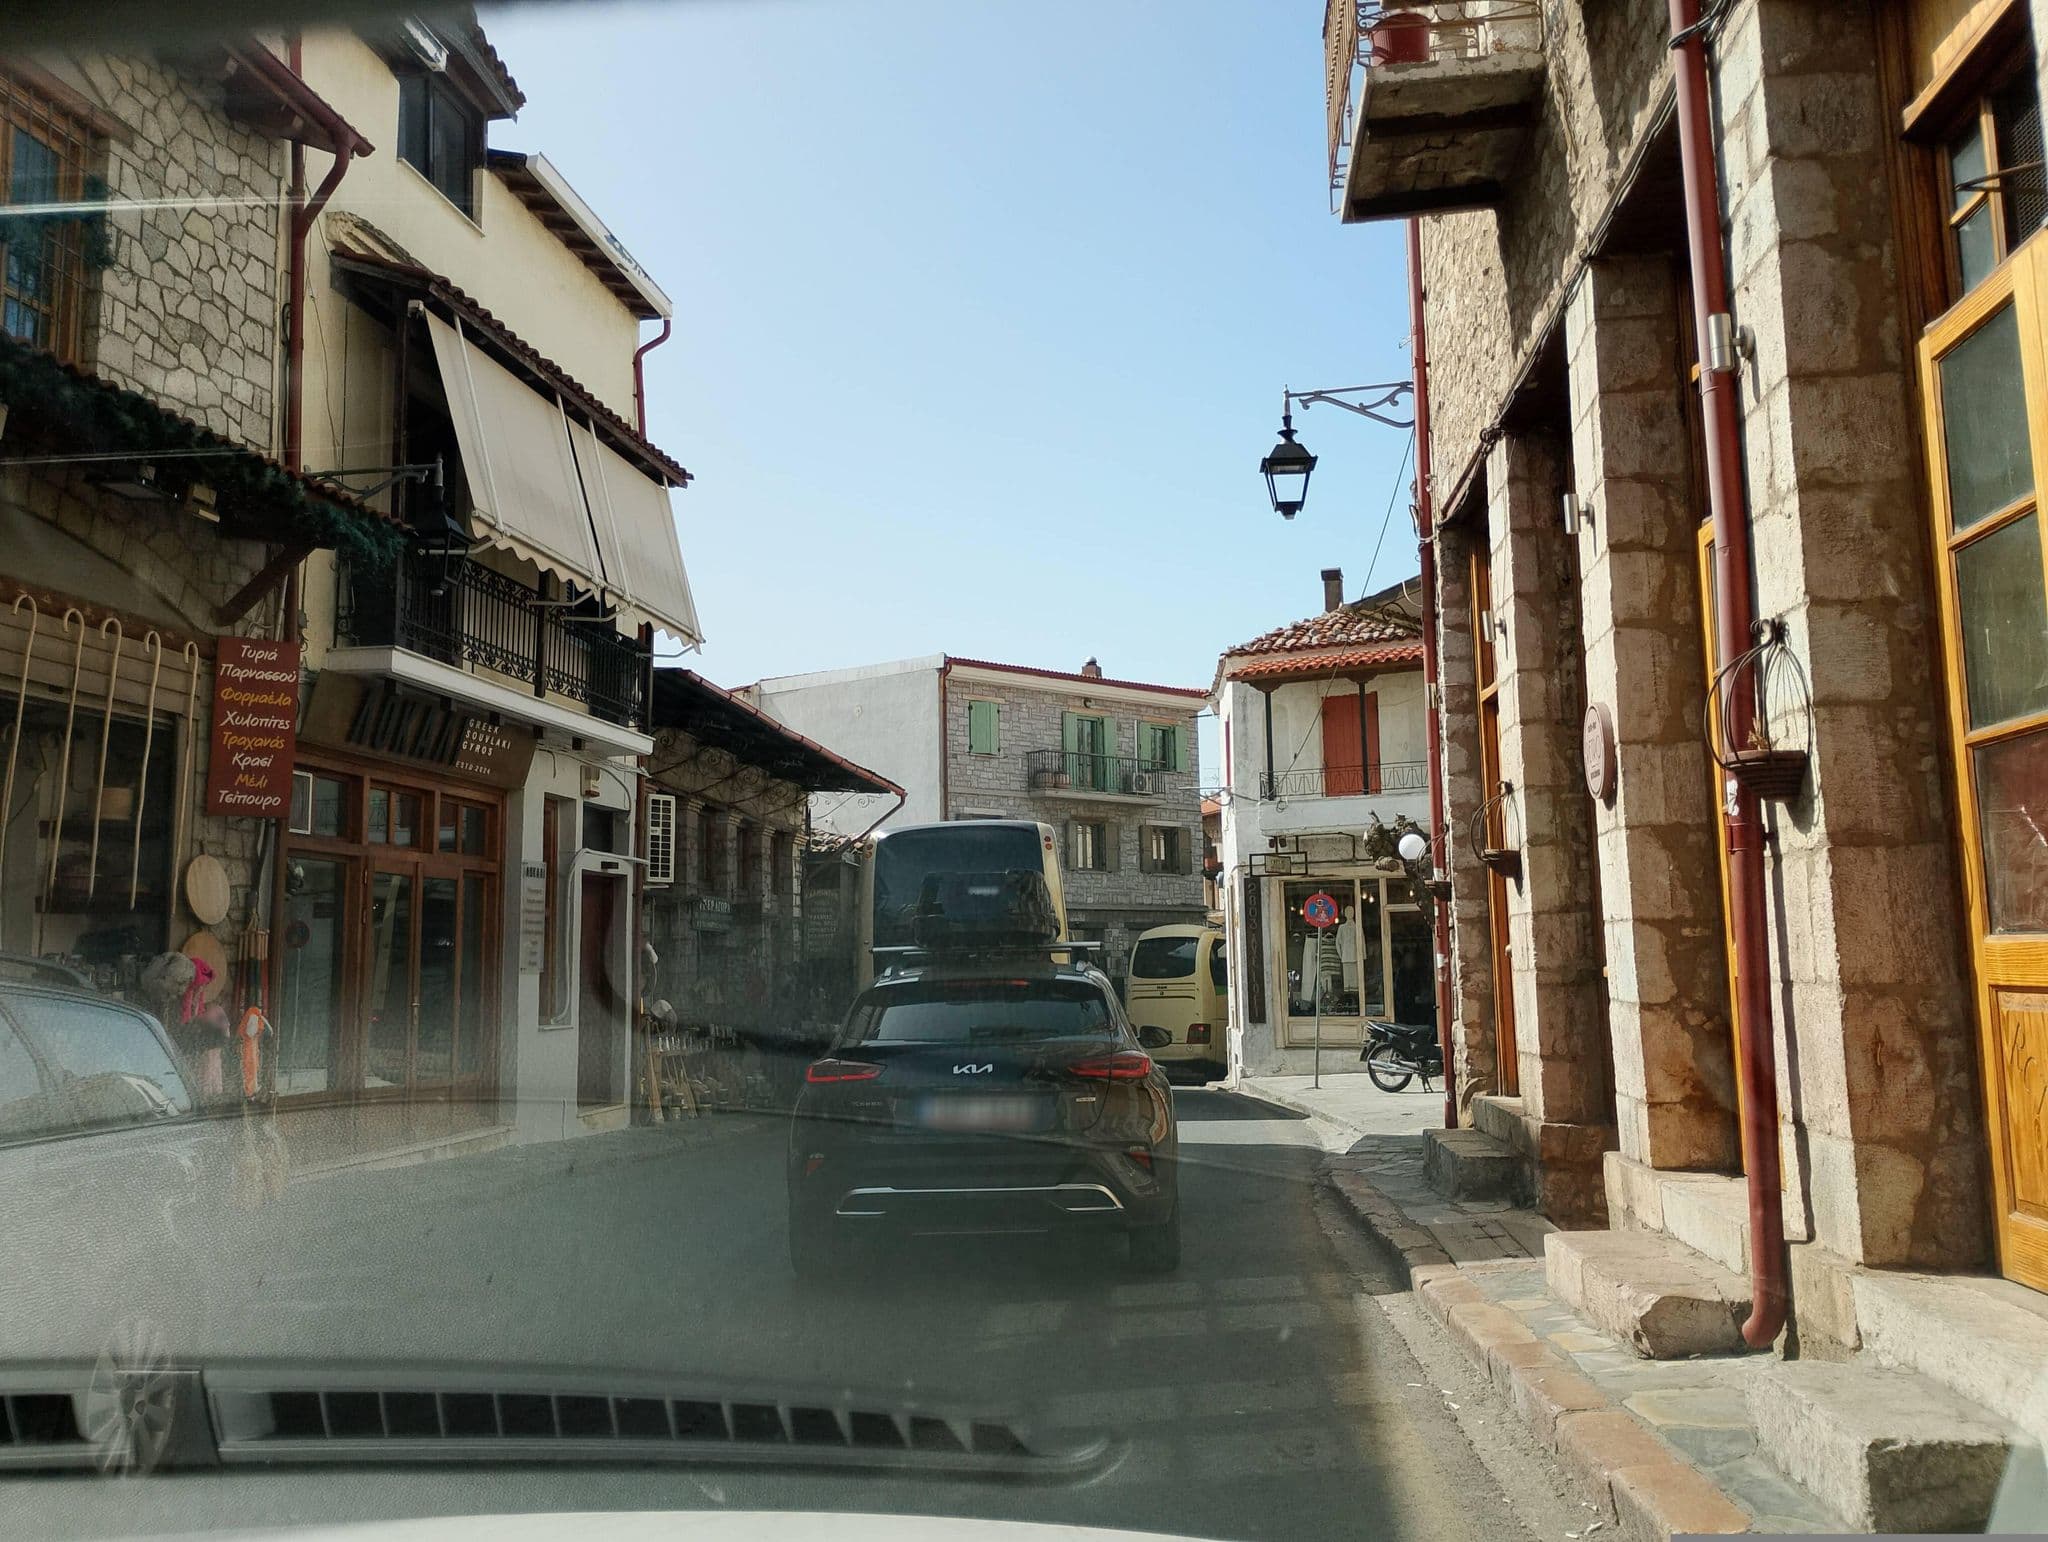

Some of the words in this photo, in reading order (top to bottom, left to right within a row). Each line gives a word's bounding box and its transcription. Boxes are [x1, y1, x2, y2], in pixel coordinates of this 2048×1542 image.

[240, 645, 278, 663] Τυριά
[219, 663, 298, 683] Παρνασσού
[220, 686, 292, 707] Φορμαέλα
[219, 710, 291, 730] Χυλοπίτες
[469, 718, 500, 735] GREEK
[222, 731, 286, 750] Τραχανάς
[463, 740, 493, 757] GYROS
[465, 730, 511, 750] SOUVLAKI
[232, 752, 274, 771] Κρασί
[234, 773, 268, 789] Μέλι
[218, 789, 282, 810] Τσίπουρο
